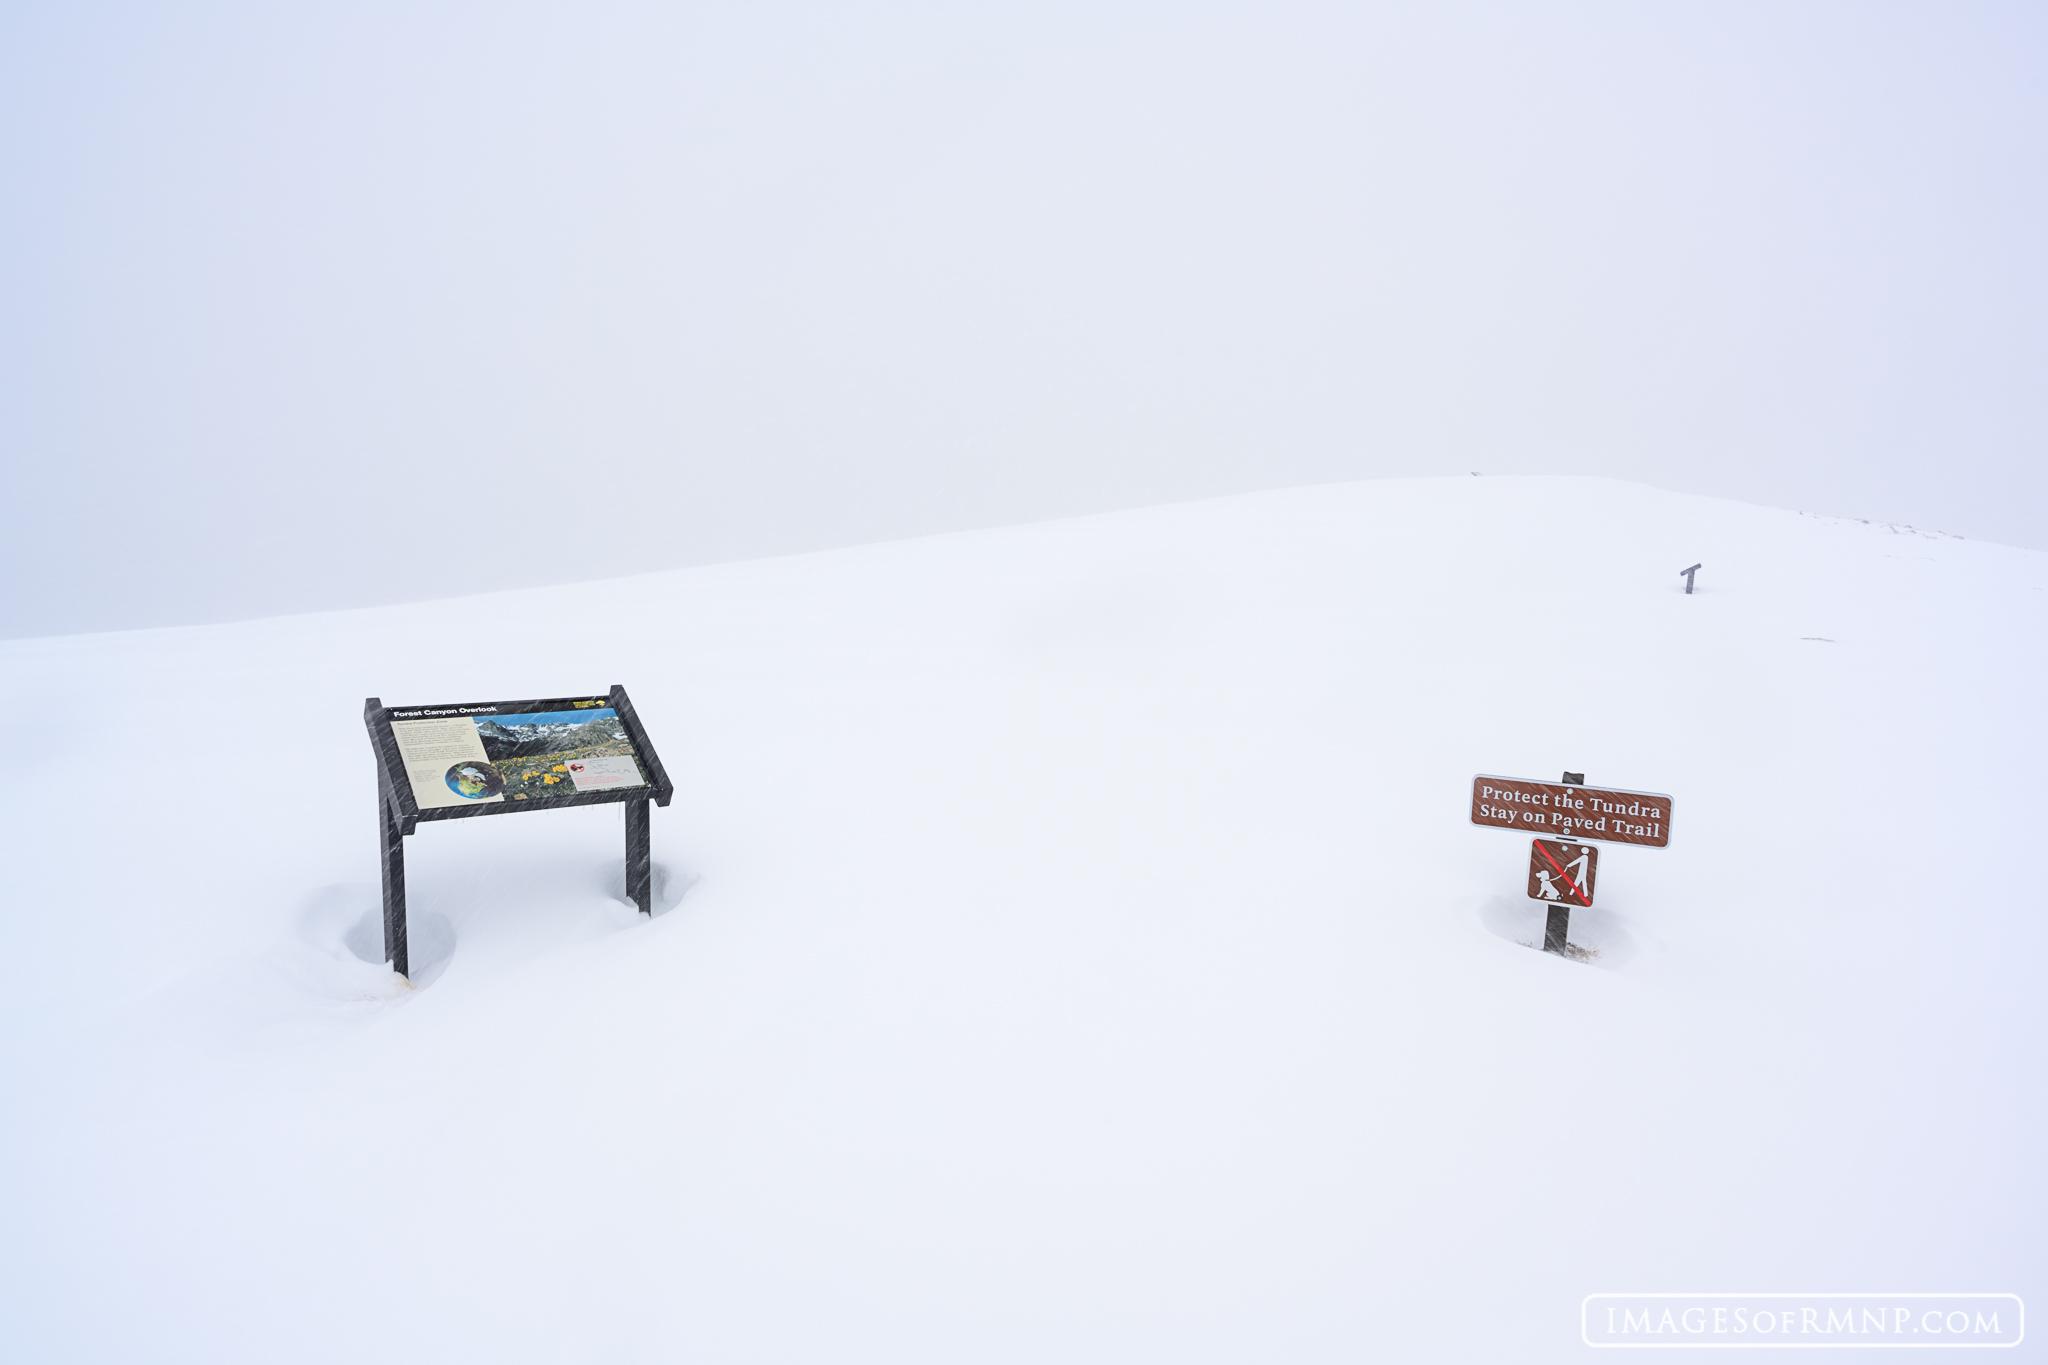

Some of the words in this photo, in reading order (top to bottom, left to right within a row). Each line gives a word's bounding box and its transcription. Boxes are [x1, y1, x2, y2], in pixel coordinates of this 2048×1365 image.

[424, 708, 457, 716] Canyon
[459, 706, 497, 714] Overlook
[1481, 785, 1549, 806] Protect
[1554, 793, 1584, 810] the
[1589, 798, 1661, 818] Tundra
[1480, 804, 1517, 824] Stay
[1522, 811, 1546, 824] on
[1551, 812, 1606, 832] Paved
[1612, 819, 1660, 838] Trail
